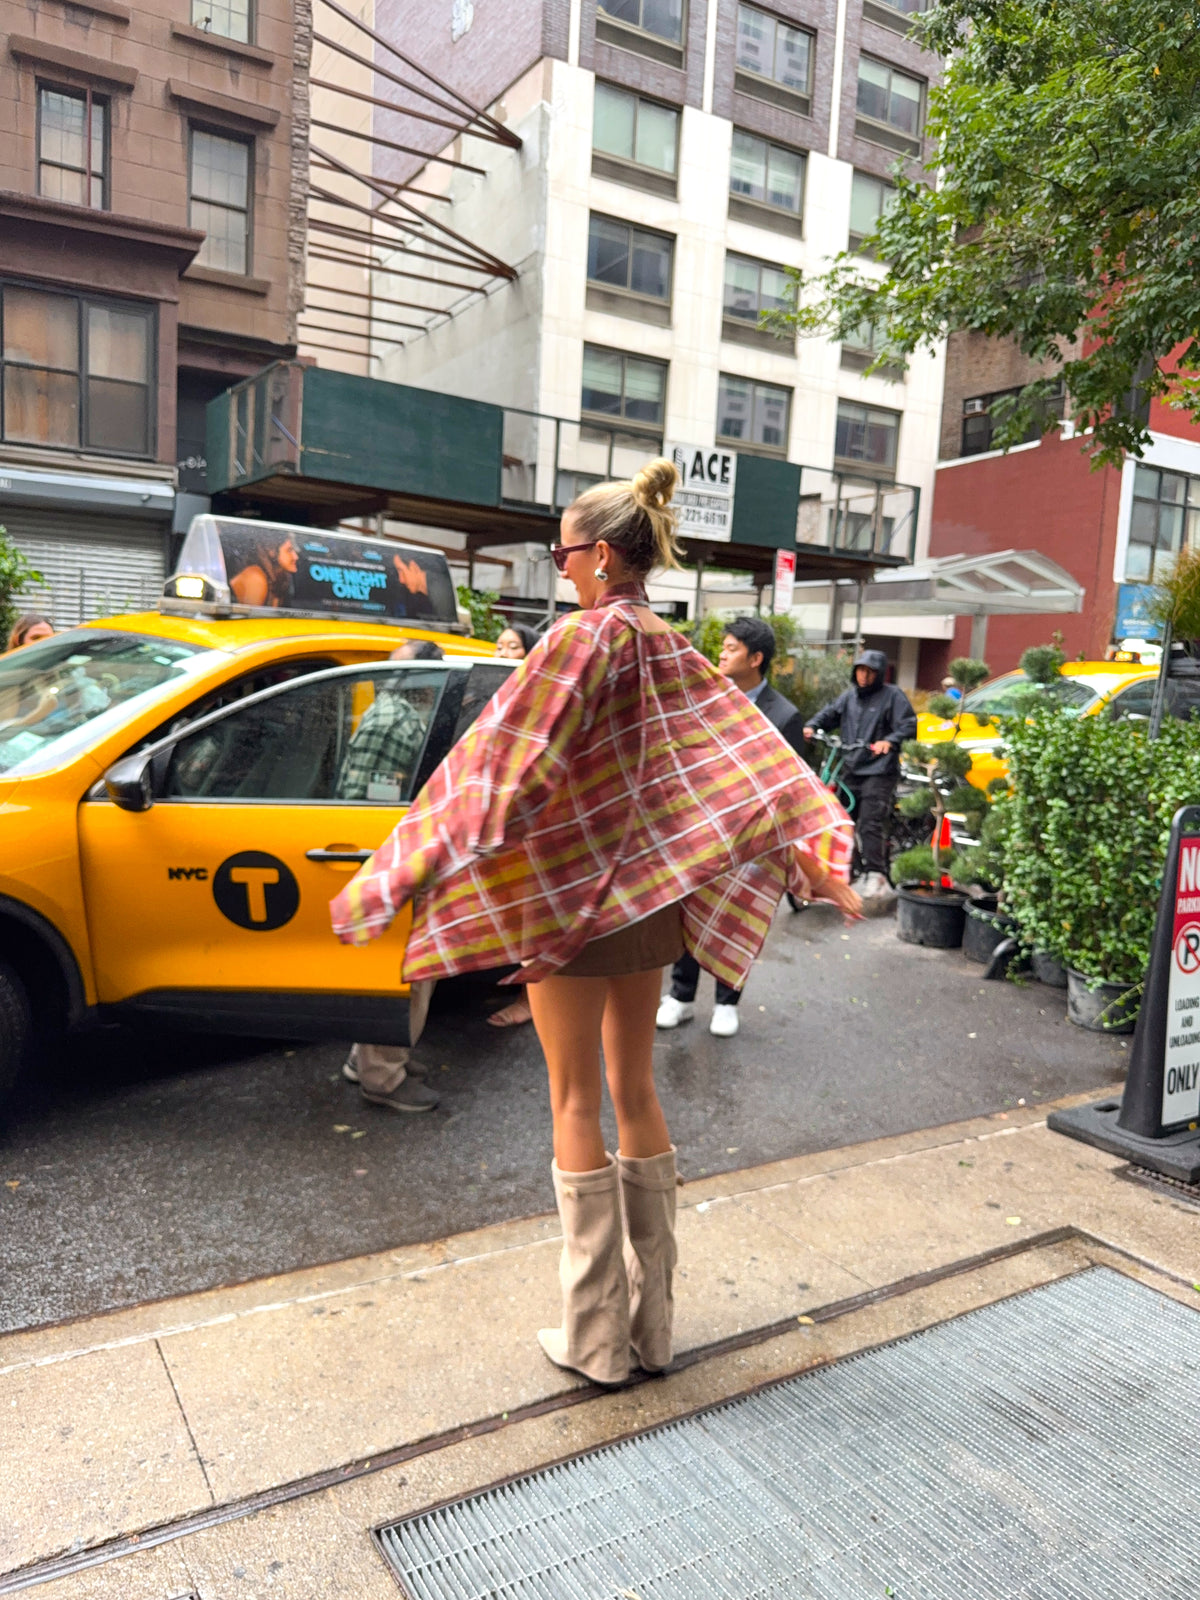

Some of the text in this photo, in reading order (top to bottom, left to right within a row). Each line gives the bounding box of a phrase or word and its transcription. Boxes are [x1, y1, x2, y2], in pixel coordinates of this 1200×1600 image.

[690, 451, 731, 484] ACE
[309, 564, 342, 584] ONE
[342, 568, 387, 589] NIGHT
[332, 582, 371, 600] ONLY
[168, 868, 208, 880] NYC
[1175, 996, 1200, 1011] LOADING
[1181, 1015, 1193, 1028] AND
[1167, 1063, 1200, 1095] ONLY
